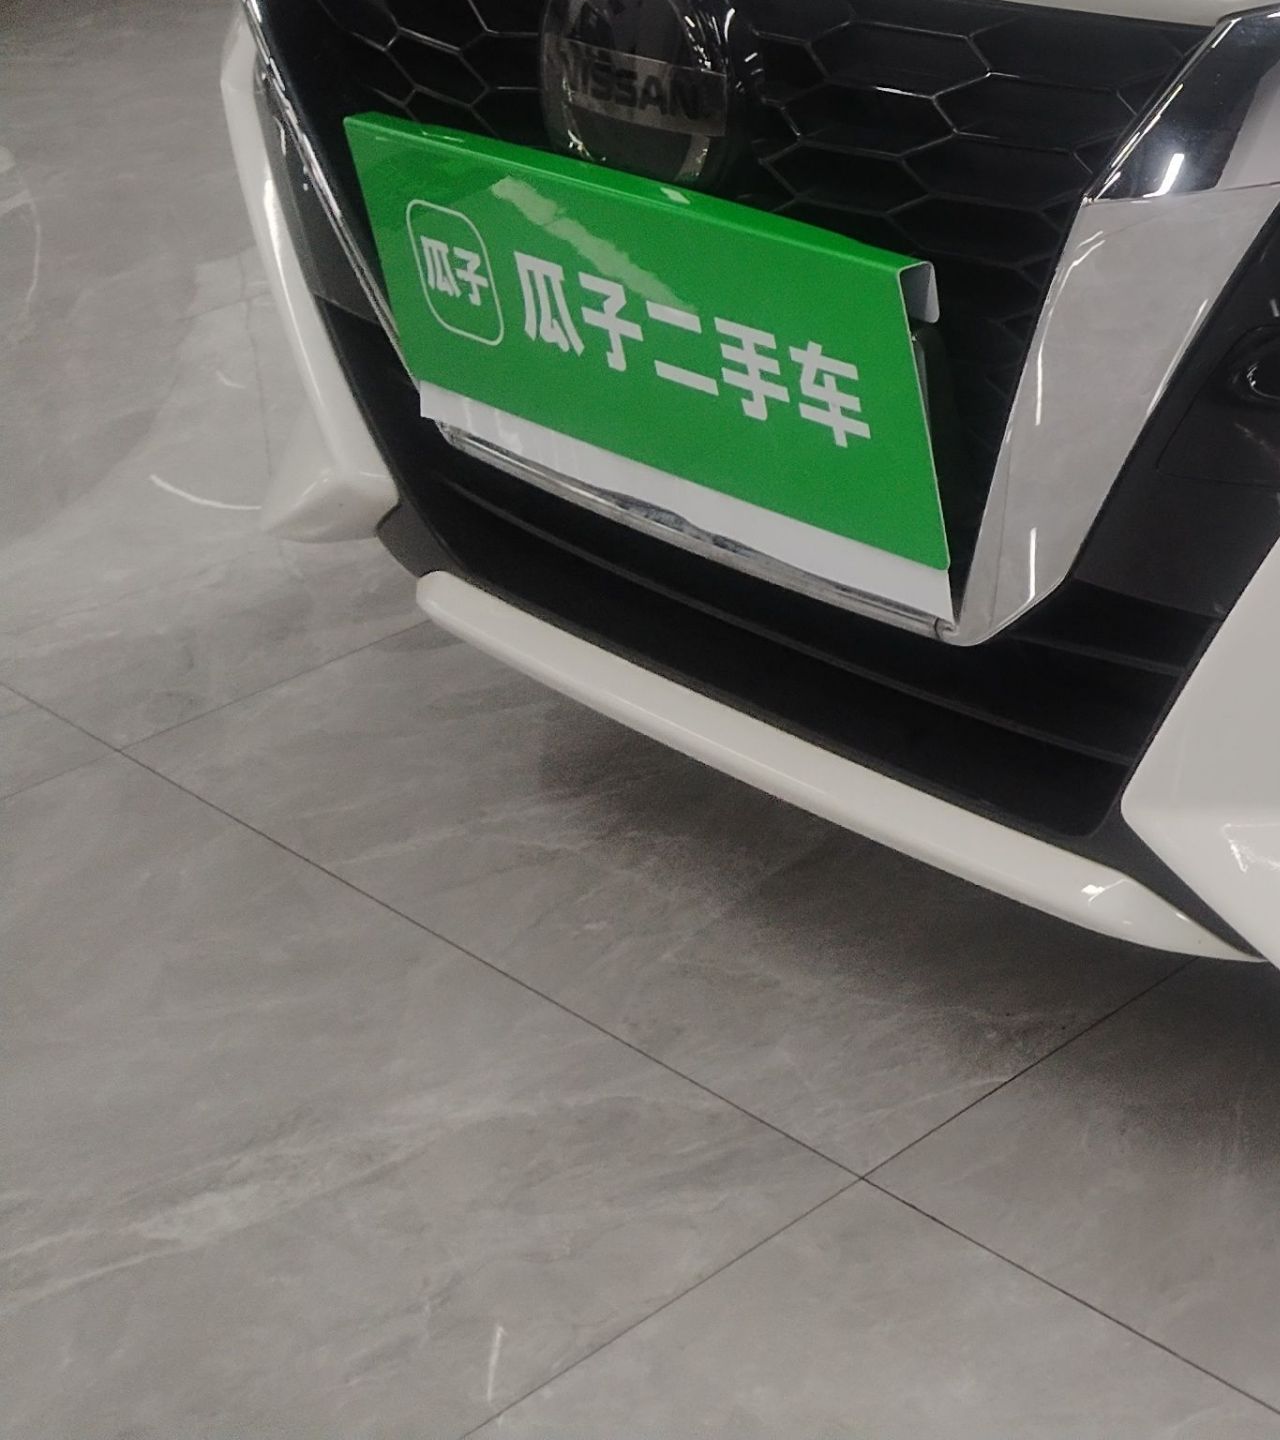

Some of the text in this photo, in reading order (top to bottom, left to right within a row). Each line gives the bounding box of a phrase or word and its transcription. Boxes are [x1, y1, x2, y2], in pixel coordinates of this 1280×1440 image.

[420, 235, 489, 306] 瓜子
[513, 250, 871, 448] 瓜子二手车
